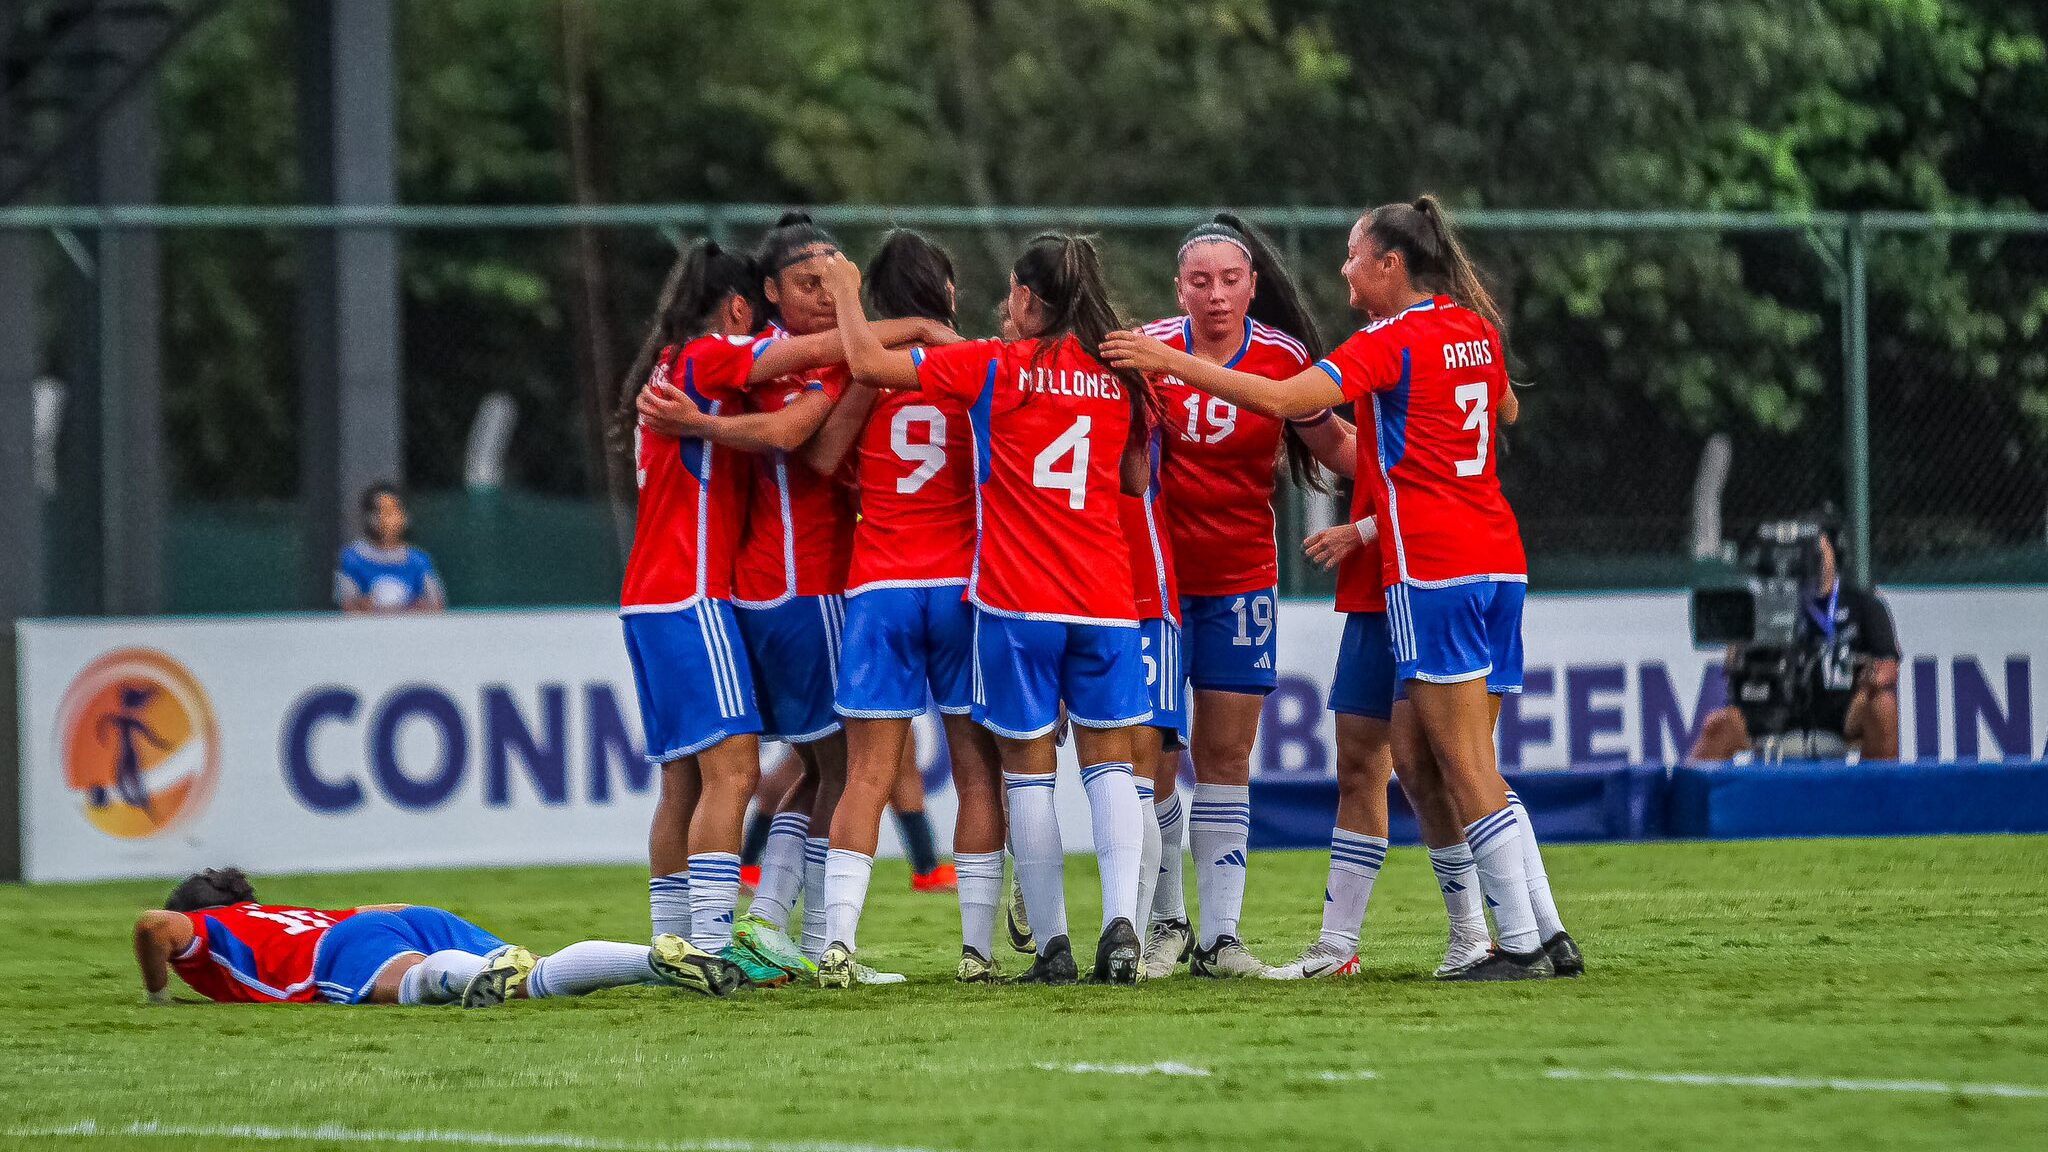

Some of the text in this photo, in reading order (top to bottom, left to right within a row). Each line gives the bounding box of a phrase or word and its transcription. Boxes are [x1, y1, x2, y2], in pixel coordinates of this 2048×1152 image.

[1443, 339, 1493, 369] ARIAS
[1018, 366, 1121, 400] MILLONES
[1182, 393, 1237, 444] 19
[1453, 381, 1490, 478] 3
[890, 405, 947, 494] 9
[1033, 415, 1092, 510] 4
[1231, 595, 1273, 646] 19
